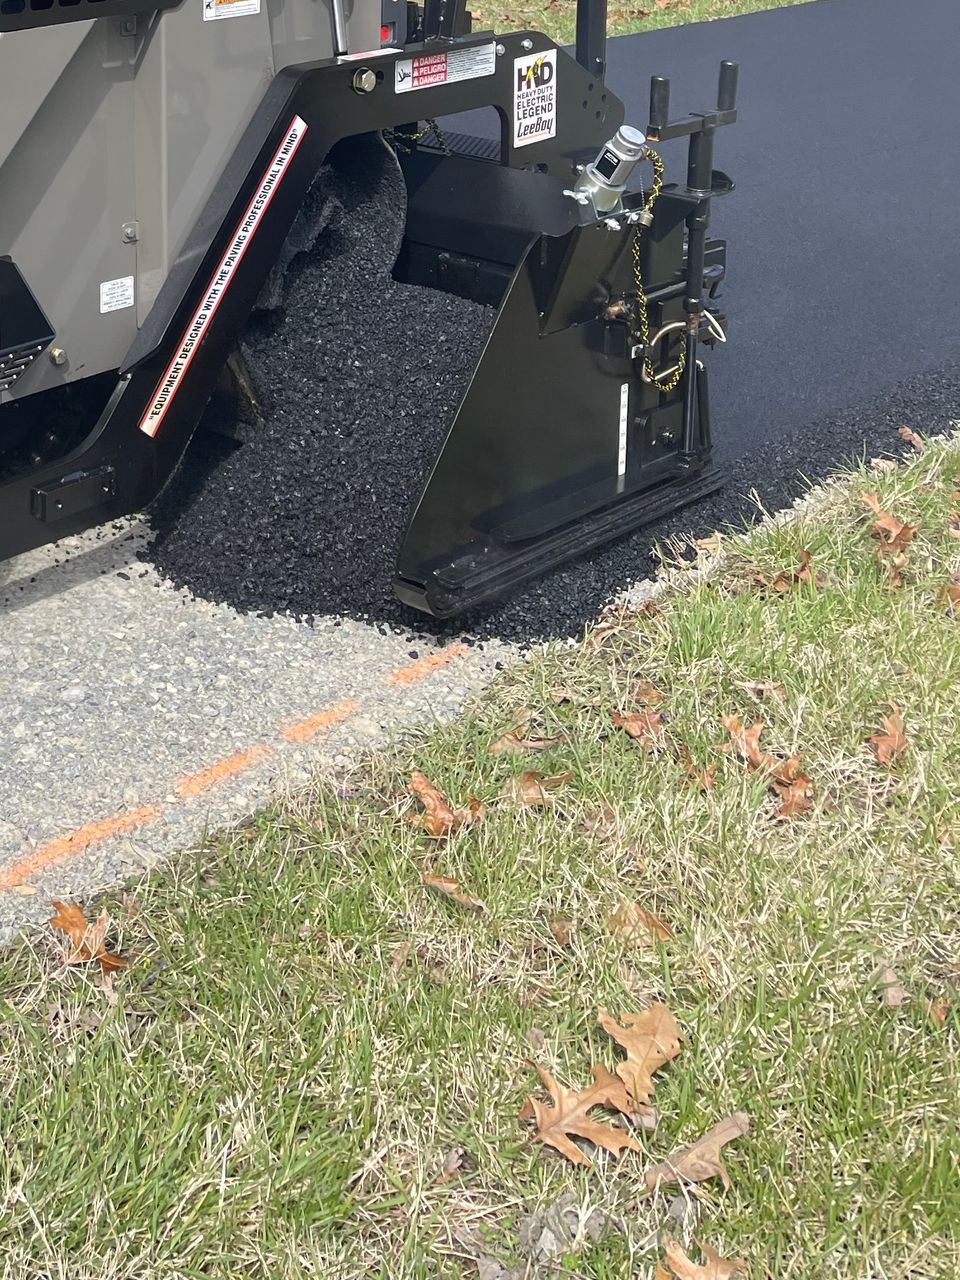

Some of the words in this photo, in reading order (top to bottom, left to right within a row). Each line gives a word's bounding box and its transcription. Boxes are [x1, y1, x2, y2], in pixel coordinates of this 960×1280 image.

[419, 54, 446, 66] DANGER
[419, 63, 447, 76] PELIGRO
[419, 73, 446, 86] DANGER
[516, 89, 537, 101] HEAVY
[537, 85, 554, 96] DUTY
[516, 92, 554, 110] ELECTRIC
[516, 102, 554, 121] LEGEND
[516, 116, 554, 138] LeeBoy
[179, 313, 208, 360] DESIGNED
[202, 287, 221, 313] WITH
[215, 267, 230, 287] THE
[224, 233, 247, 268] PAVING
[242, 167, 281, 233] PROFESSIONAL
[275, 156, 286, 167] IN
